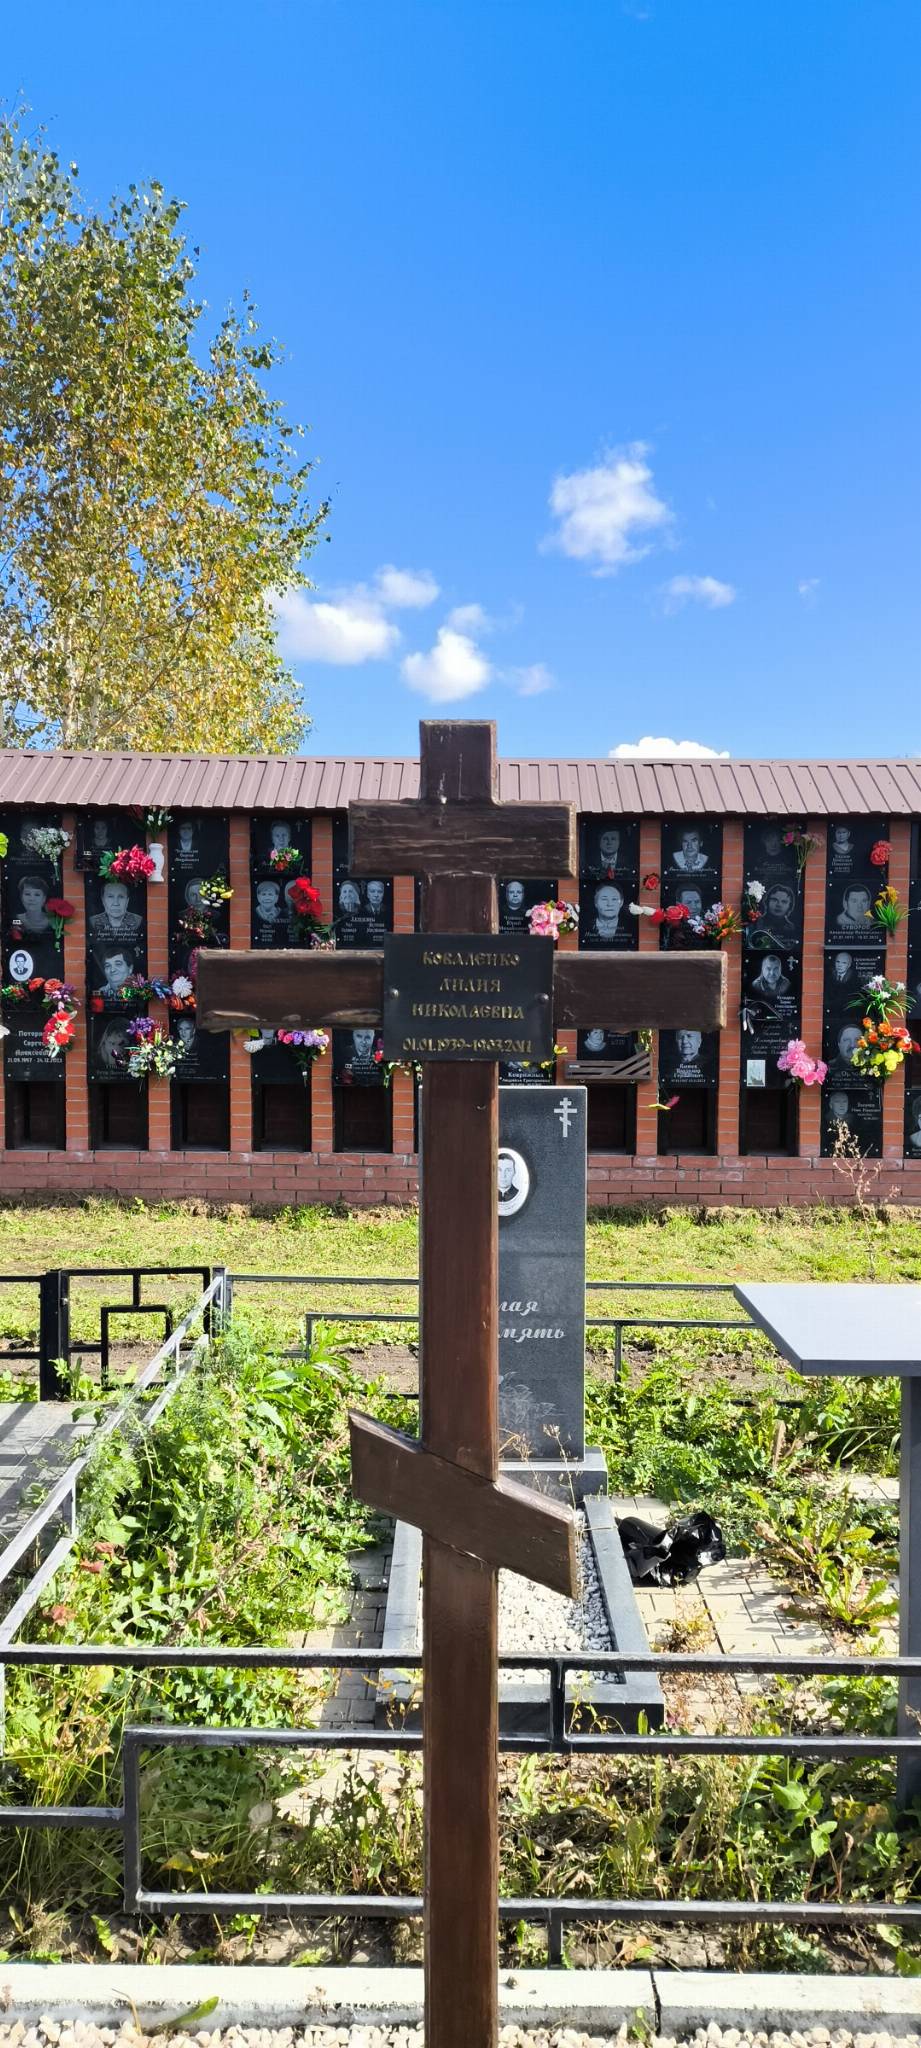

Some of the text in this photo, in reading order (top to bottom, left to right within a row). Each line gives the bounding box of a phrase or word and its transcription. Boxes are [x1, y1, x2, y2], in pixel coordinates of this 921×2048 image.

[423, 951, 520, 966] КОВАЛЕНКО
[439, 977, 501, 993] ЛИЛИЯ
[412, 1003, 525, 1020] НИКОЛАЕВНА
[498, 1301, 540, 1316] лая
[498, 1327, 567, 1343] мять
